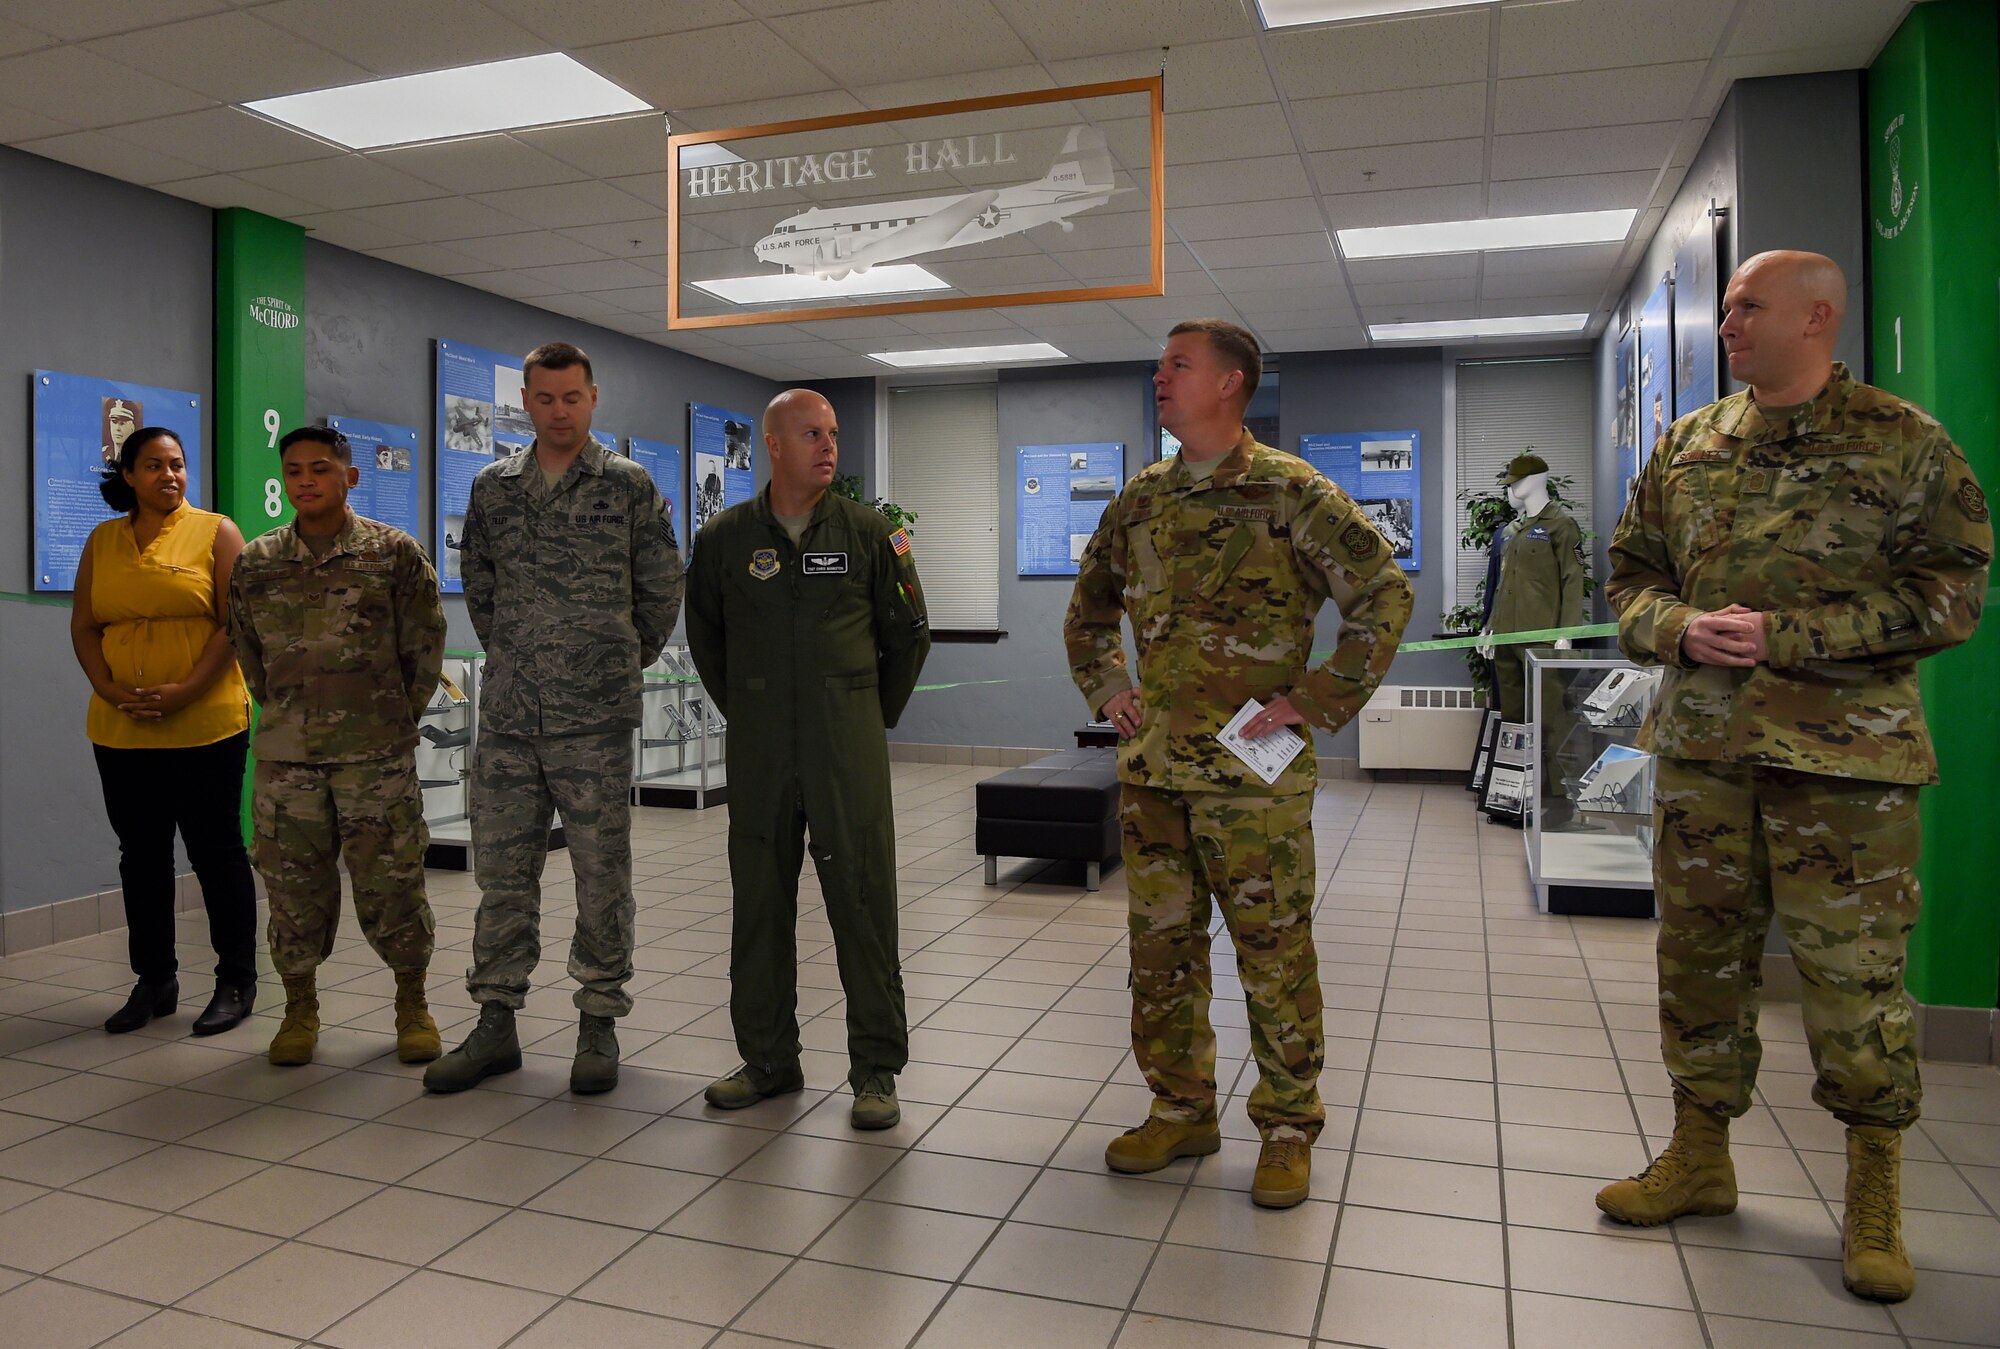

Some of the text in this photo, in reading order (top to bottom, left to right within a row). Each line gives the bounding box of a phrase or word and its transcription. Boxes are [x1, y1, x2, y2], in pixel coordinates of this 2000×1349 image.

[687, 133, 1017, 198] HERITAGE HALL
[778, 241, 791, 249] AIR
[795, 237, 820, 247] FORCE
[256, 296, 291, 311] THE SPIRIT OF
[250, 304, 299, 329] McCHORD
[1895, 316, 1901, 374] 1
[264, 409, 280, 448] 9
[1846, 440, 1881, 452] FORCE
[265, 478, 283, 518] 8
[589, 515, 601, 523] AIR
[603, 514, 625, 524] FORCE
